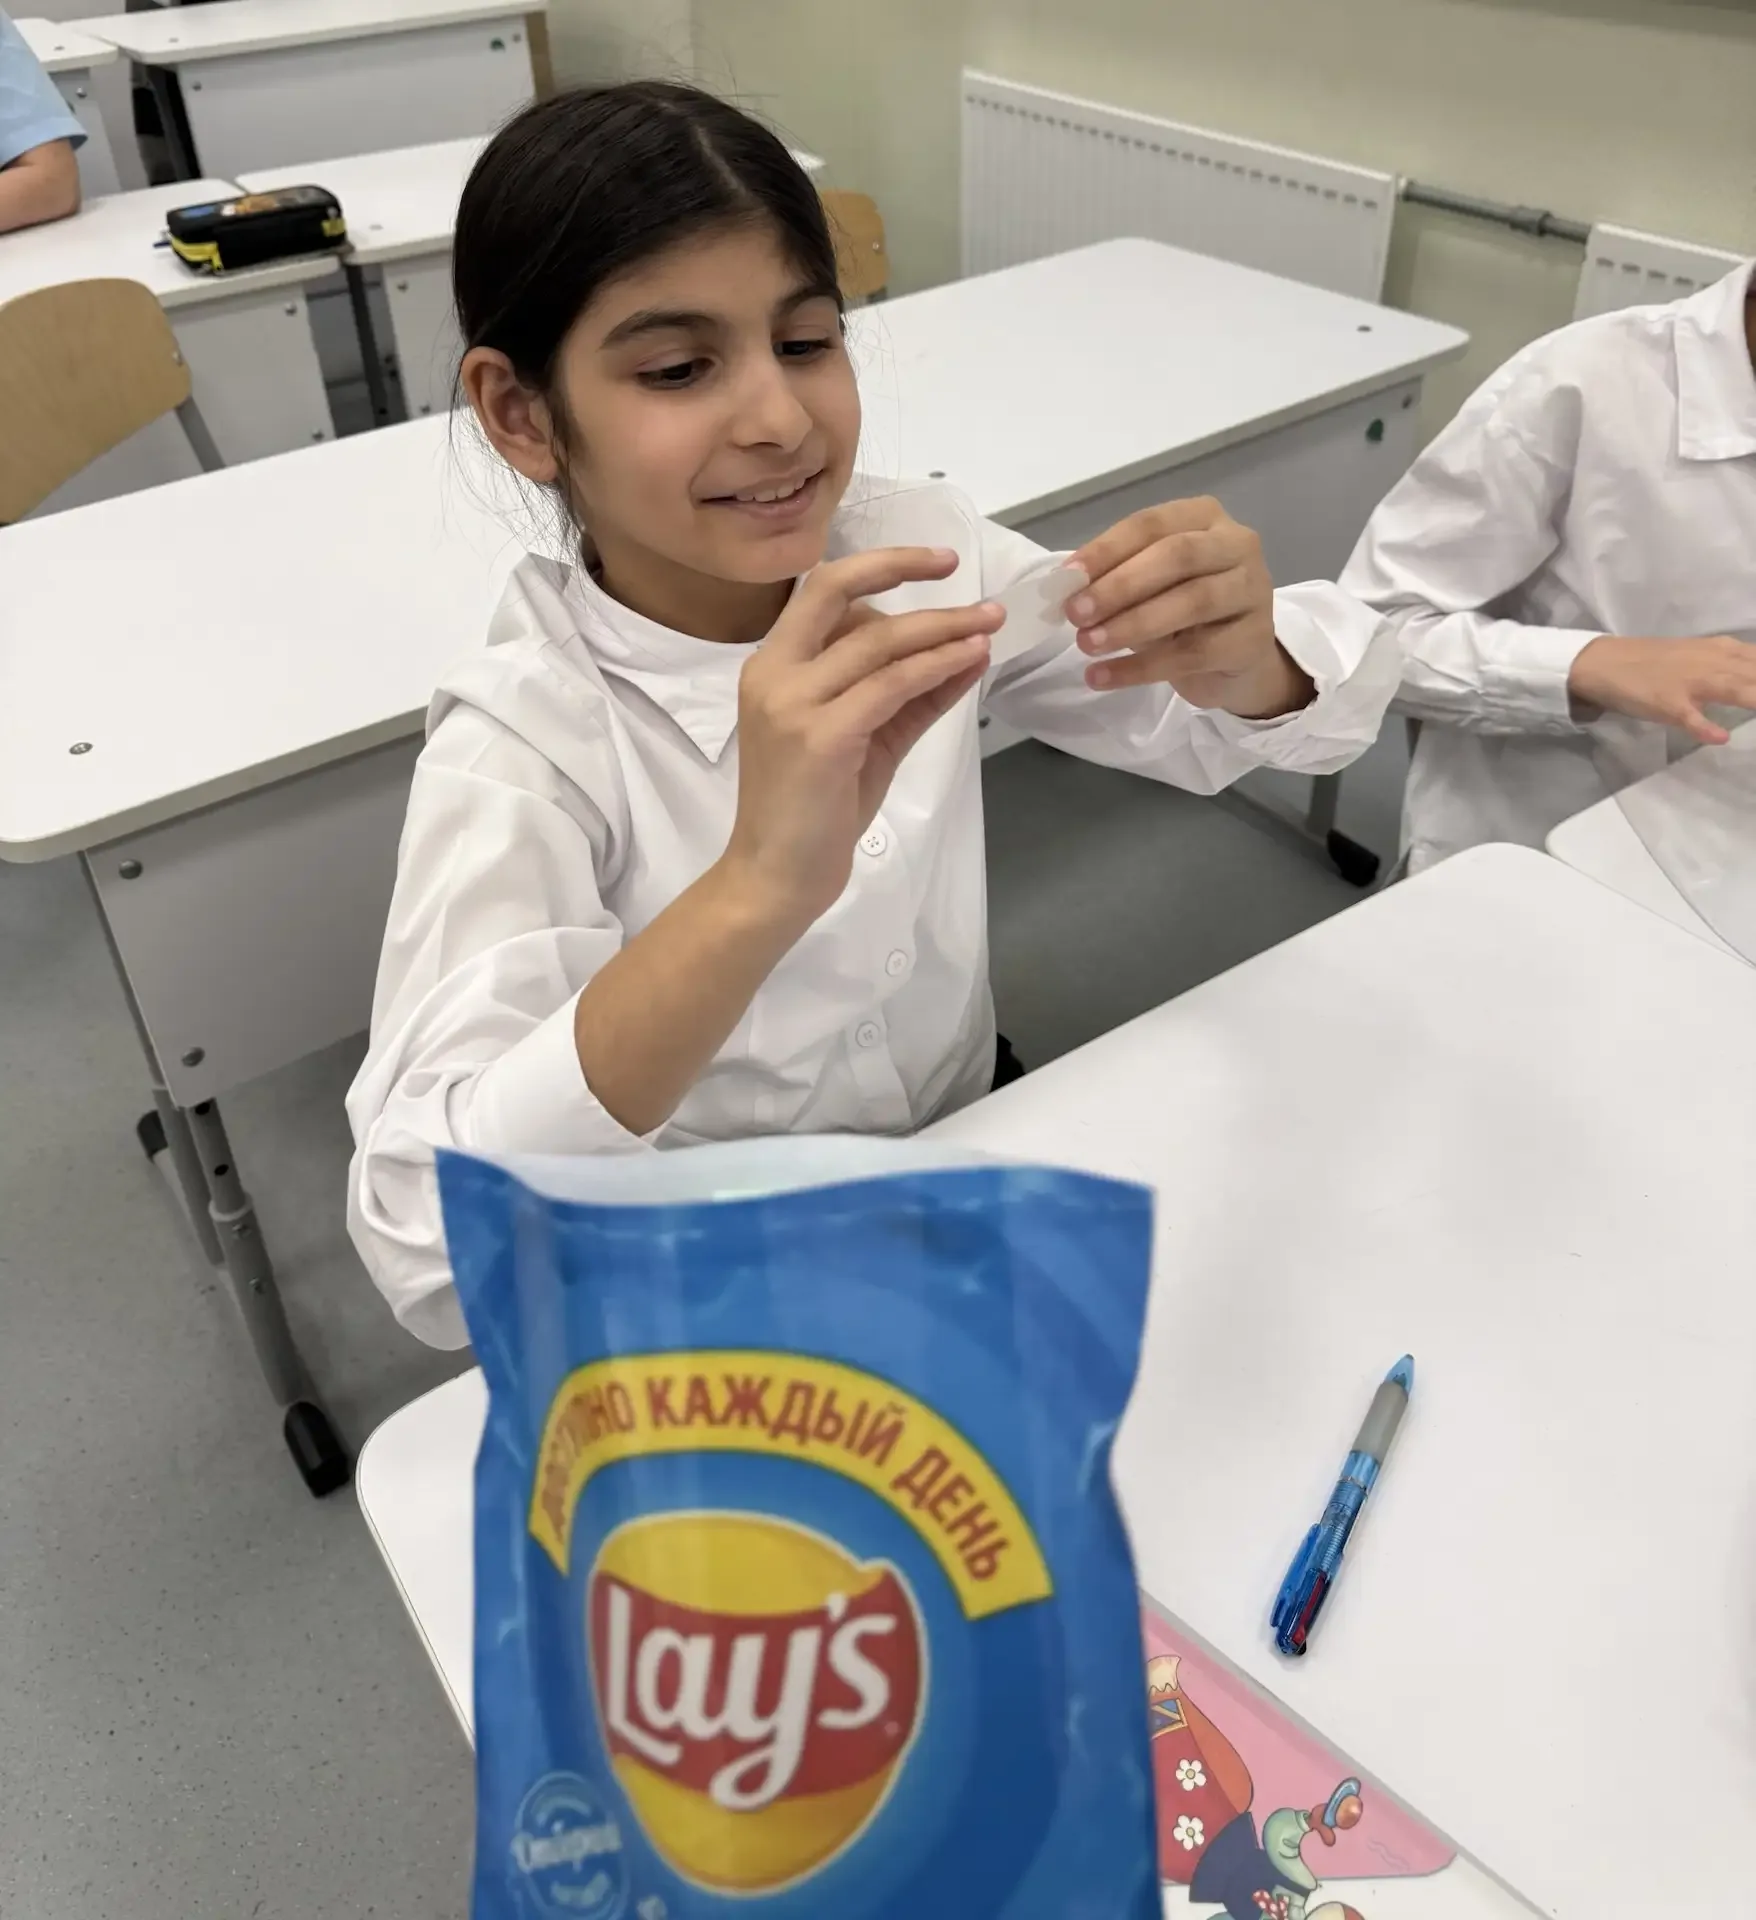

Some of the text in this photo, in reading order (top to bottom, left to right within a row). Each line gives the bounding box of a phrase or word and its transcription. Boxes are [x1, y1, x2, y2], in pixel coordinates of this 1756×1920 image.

[645, 1373, 907, 1467] КАЖДЫЙ
[889, 1444, 1010, 1581] ДЕНЬ
[607, 1582, 897, 1810] Lay's
